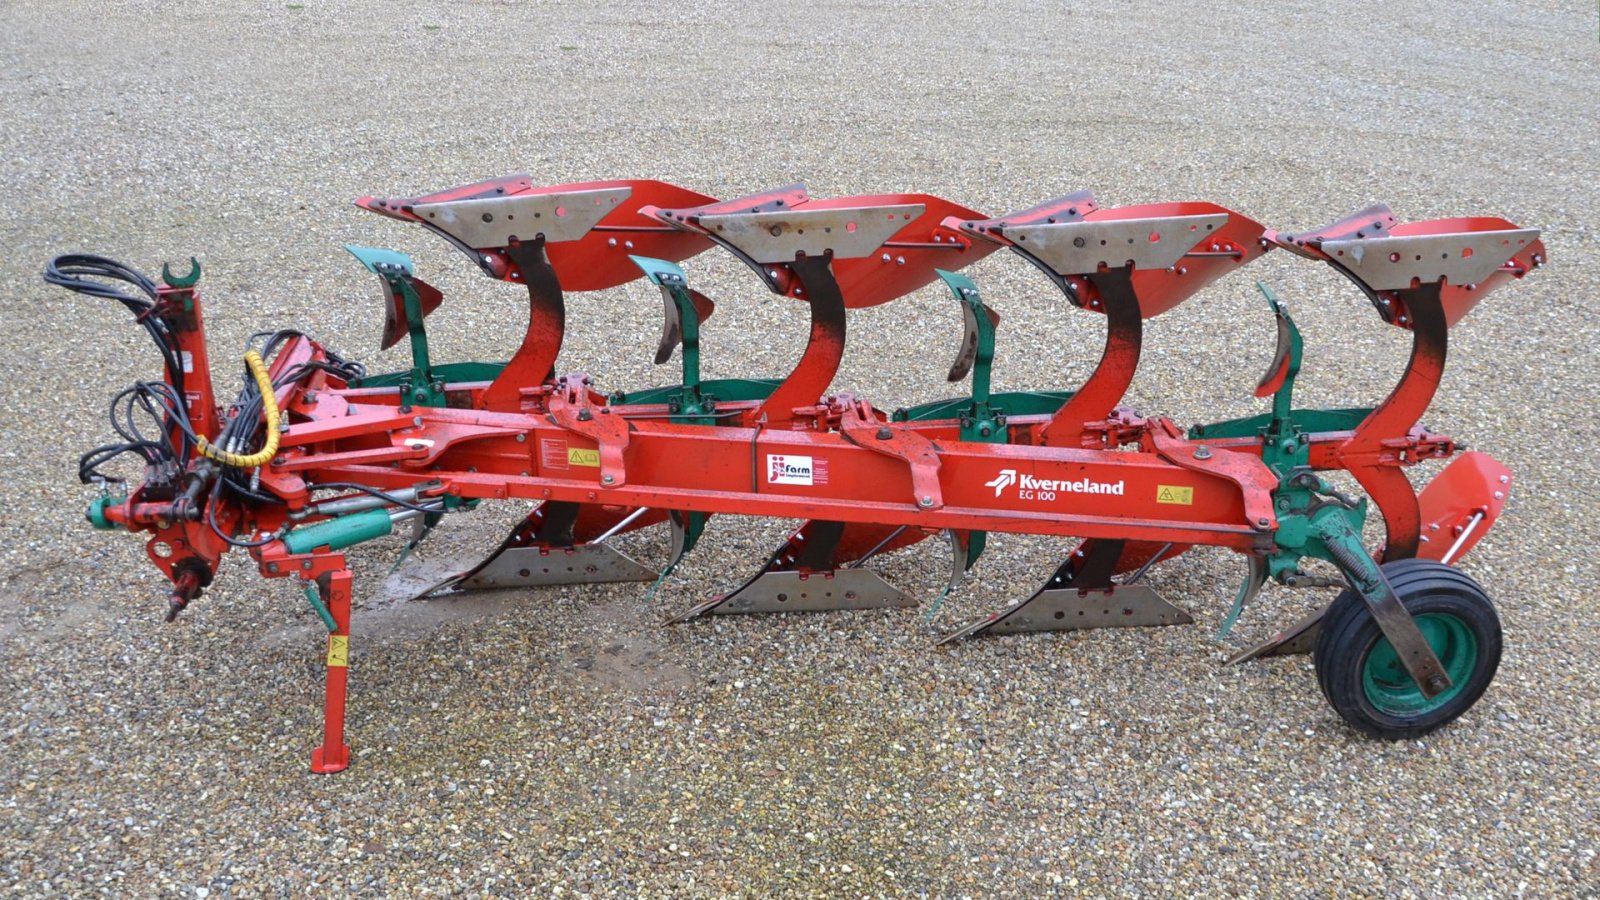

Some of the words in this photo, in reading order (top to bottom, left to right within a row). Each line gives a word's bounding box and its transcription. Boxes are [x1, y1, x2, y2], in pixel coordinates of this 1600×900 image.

[1019, 474, 1124, 496] Kverneland
[1019, 490, 1034, 500] EG
[1037, 491, 1056, 501] 100
